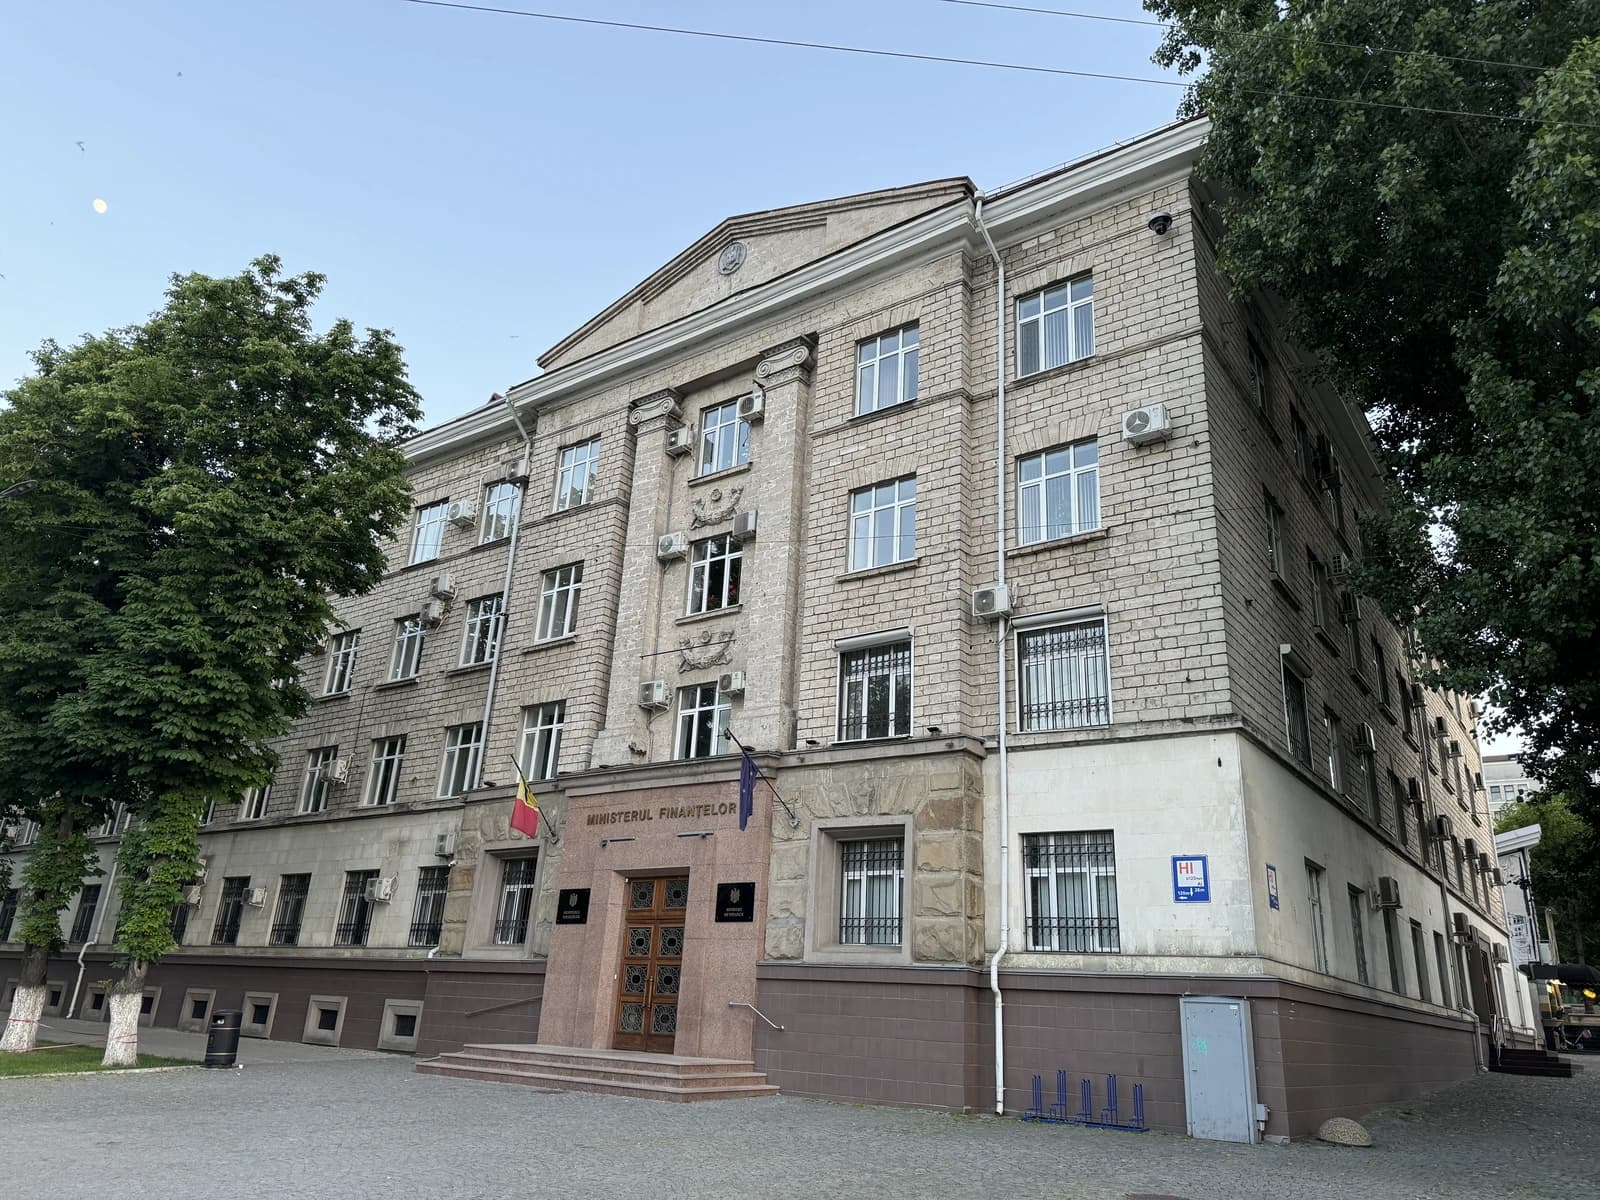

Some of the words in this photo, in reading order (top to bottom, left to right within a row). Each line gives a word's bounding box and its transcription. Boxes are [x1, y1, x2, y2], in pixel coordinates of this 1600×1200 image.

[586, 808, 653, 826] MINISTERUL
[659, 802, 737, 819] FINANȚELOR
[1178, 861, 1194, 875] HI
